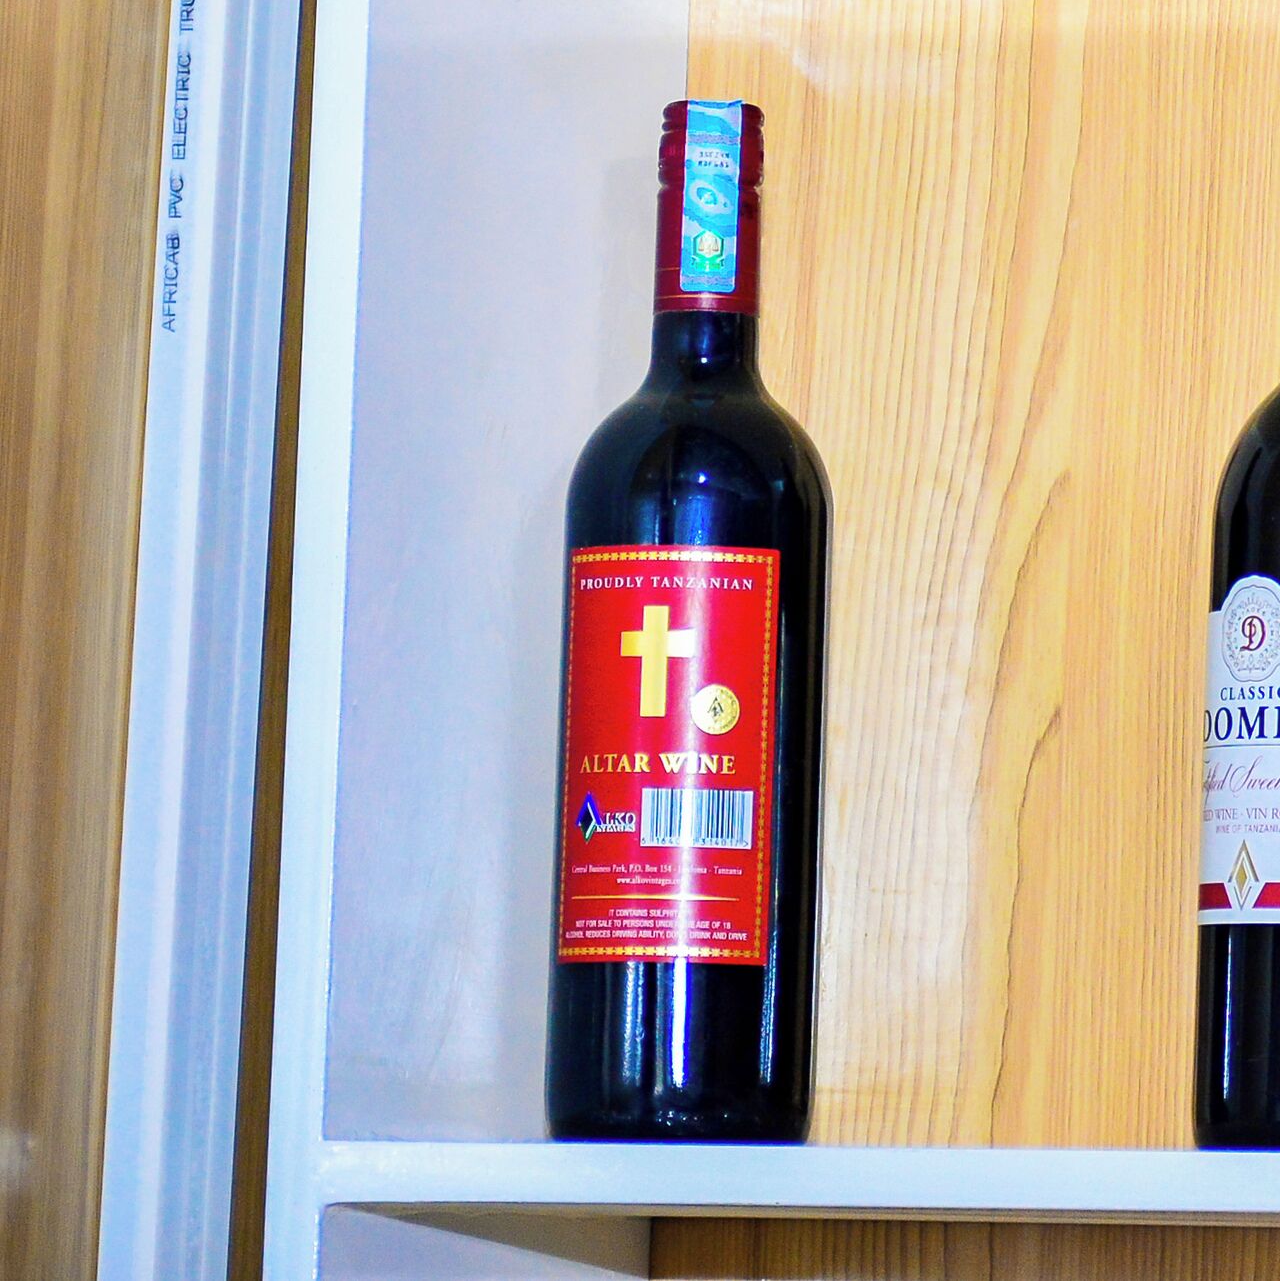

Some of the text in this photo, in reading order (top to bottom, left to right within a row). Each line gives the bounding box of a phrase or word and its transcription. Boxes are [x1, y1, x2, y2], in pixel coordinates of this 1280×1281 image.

[172, 54, 192, 160] ELECTRIC
[168, 176, 185, 219] PVC
[161, 233, 181, 333] AFRICAB
[580, 576, 753, 591] PROUDLY TANZANIAN
[580, 751, 736, 775] ALTAR WINE
[1246, 808, 1268, 820] VIN
